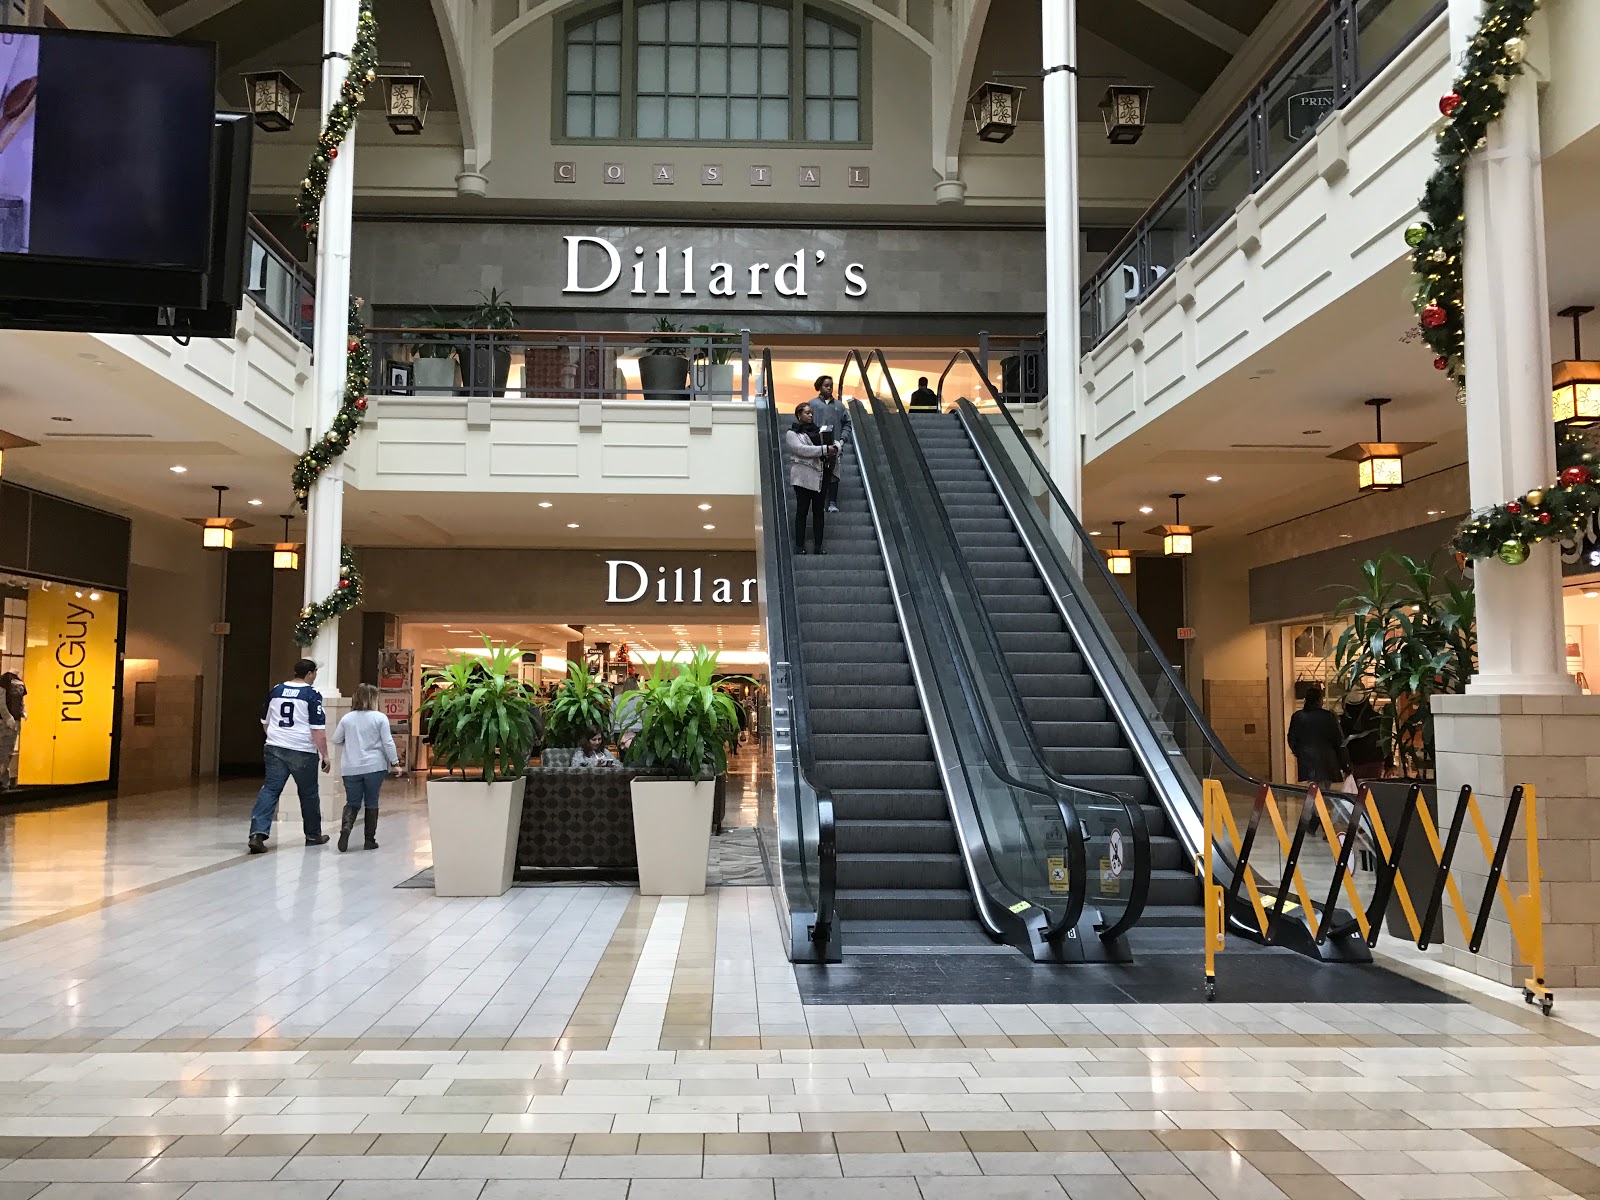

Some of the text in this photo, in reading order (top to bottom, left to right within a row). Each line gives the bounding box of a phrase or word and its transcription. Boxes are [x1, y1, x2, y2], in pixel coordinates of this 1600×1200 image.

[1301, 97, 1334, 106] PRIN
[559, 165, 864, 182] COASTAL
[562, 235, 867, 297] Dillard's
[605, 560, 757, 603] Dillar
[56, 602, 95, 722] rueGuy
[279, 701, 295, 727] 9
